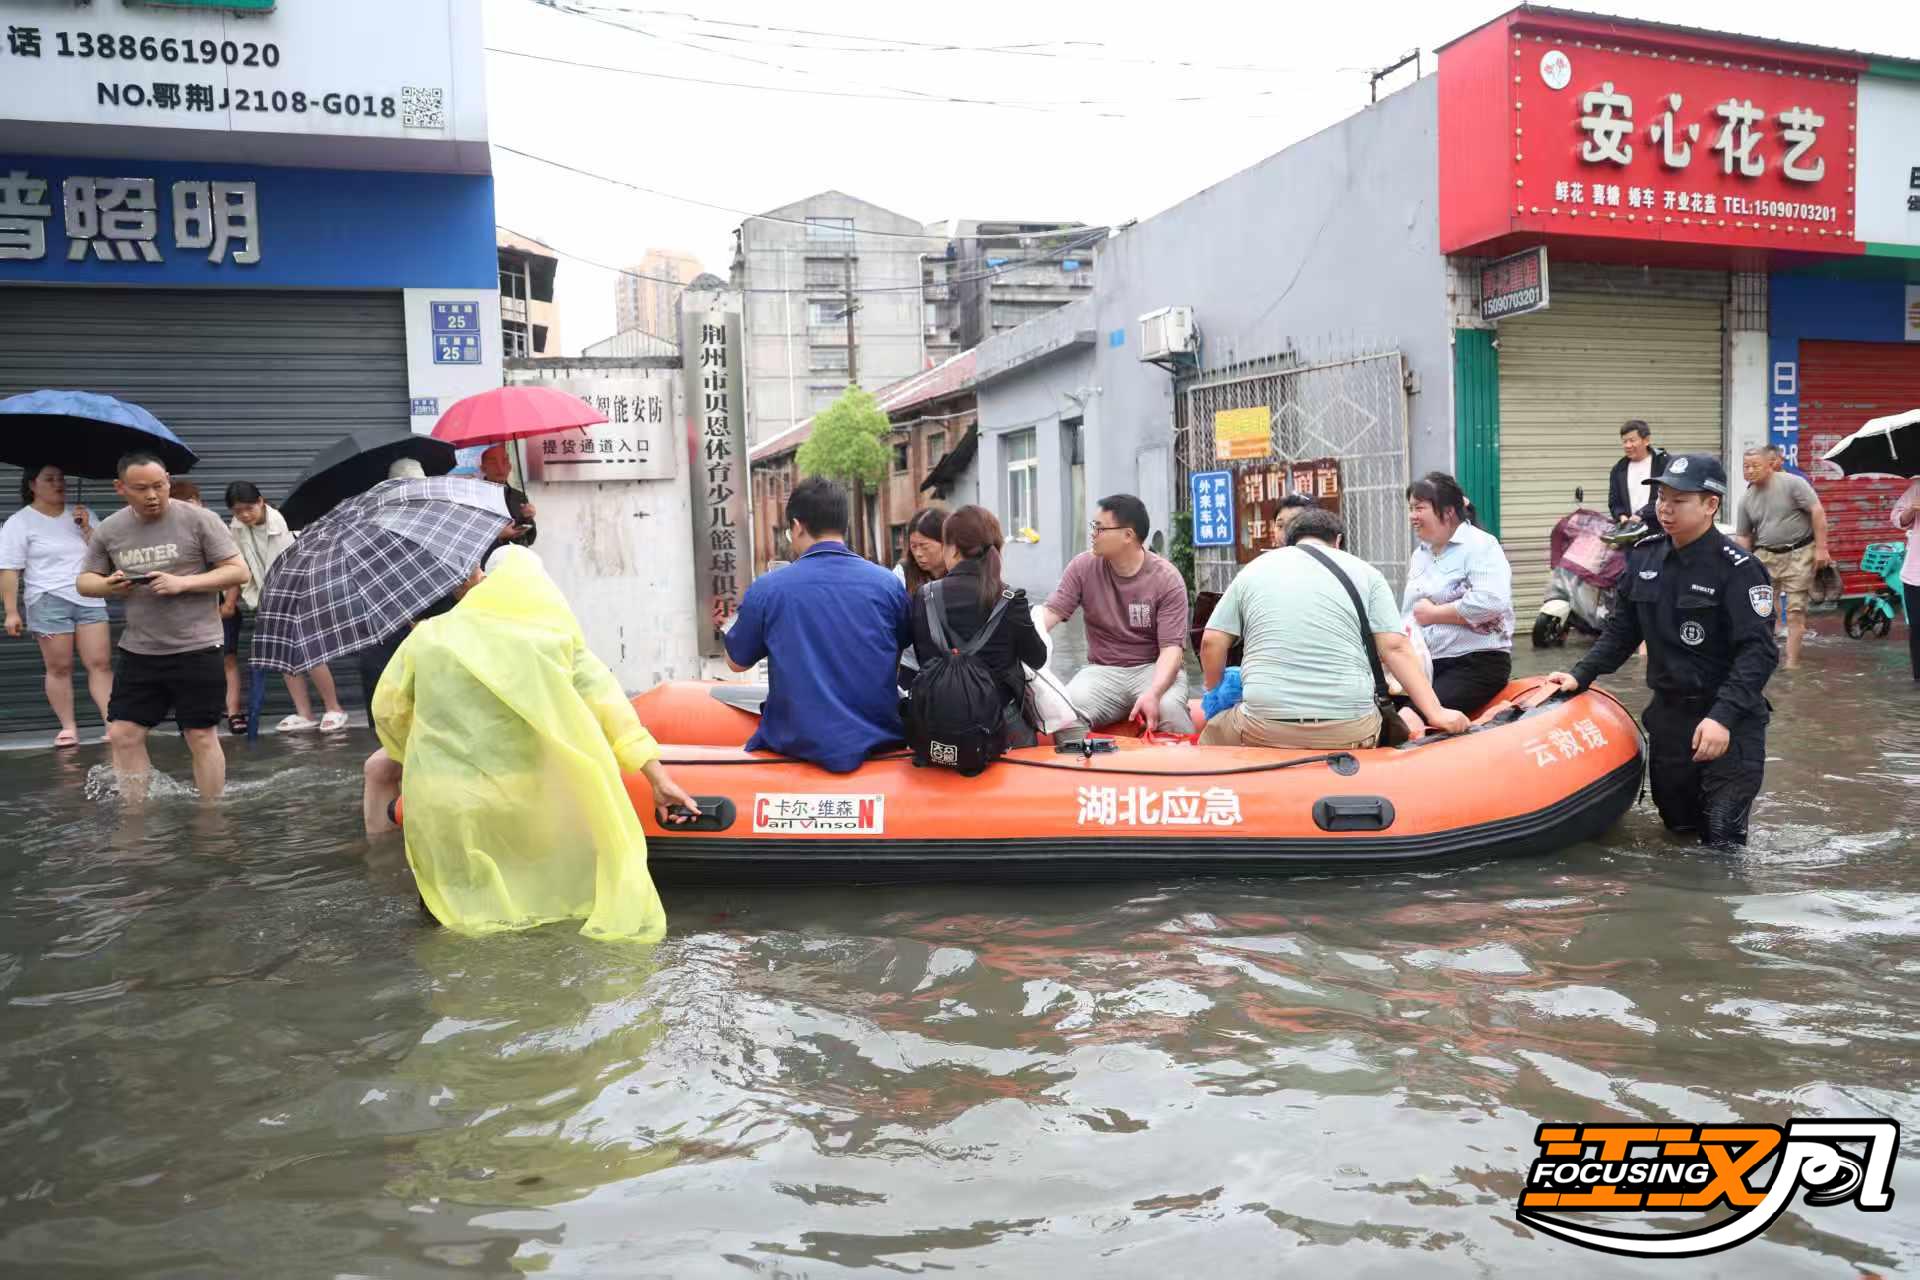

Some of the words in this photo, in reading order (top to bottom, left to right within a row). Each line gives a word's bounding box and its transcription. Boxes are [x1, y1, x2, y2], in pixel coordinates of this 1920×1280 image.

[0, 25, 41, 58] 话
[55, 31, 281, 67] 13886619020
[1580, 82, 1826, 184] 安心花艺
[1555, 181, 1584, 204] 鲜花
[1592, 184, 1620, 207] 喜糖
[1628, 186, 1655, 209] 婚车
[1723, 196, 1837, 222] TEL:15090703201
[447, 315, 466, 329] 25
[1483, 287, 1540, 316] 15090703201
[442, 346, 461, 361] 25
[1773, 361, 1799, 438] 日丰
[542, 438, 649, 455] 提货通道入口
[699, 323, 738, 641] 荆州市贝恩体育少儿篮球俱乐
[1214, 478, 1228, 539] 严禁入内
[119, 543, 179, 566] WATER
[1522, 718, 1609, 768] 云救援
[1076, 785, 1244, 826] 湖北应急
